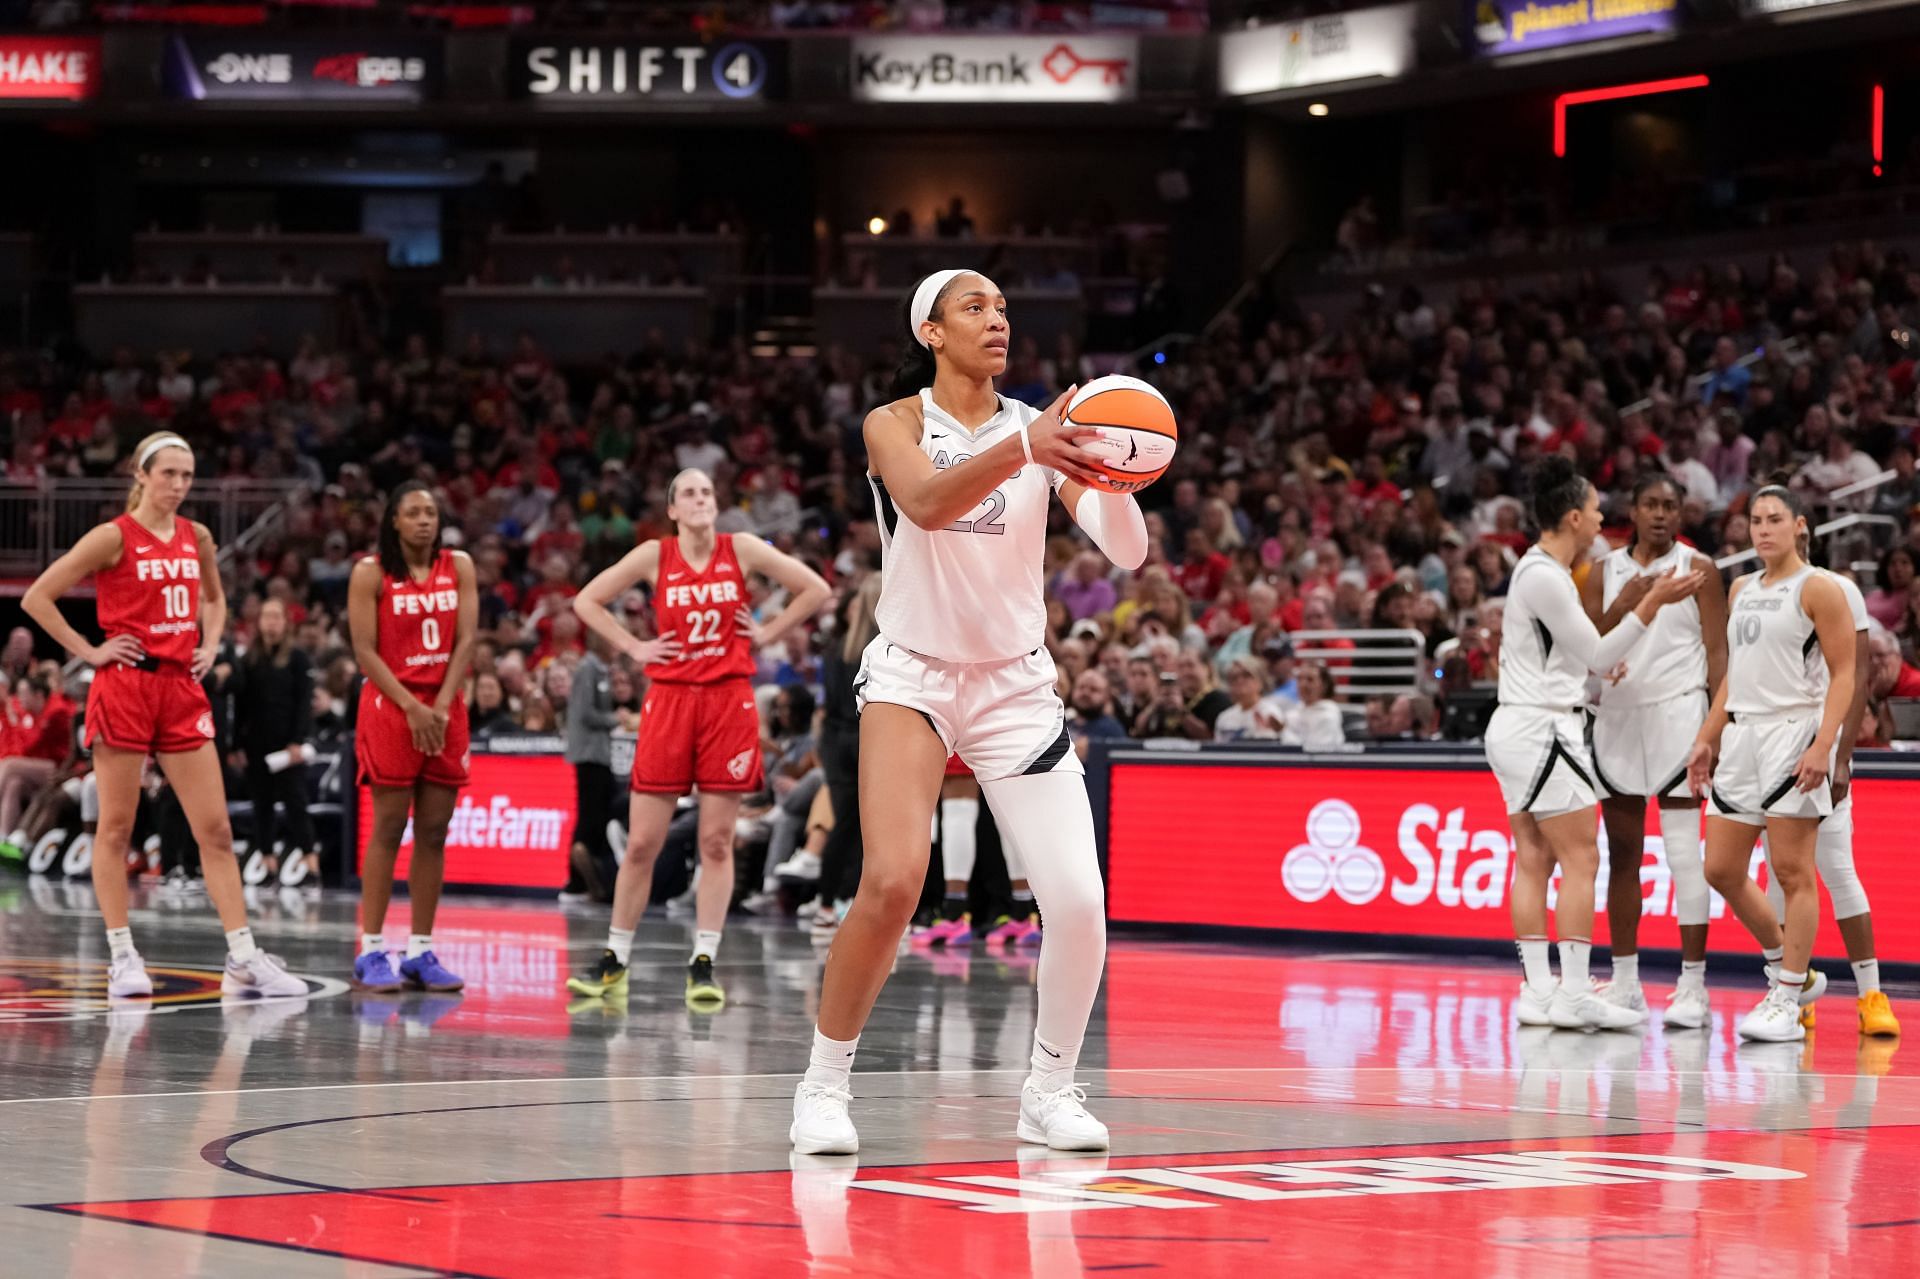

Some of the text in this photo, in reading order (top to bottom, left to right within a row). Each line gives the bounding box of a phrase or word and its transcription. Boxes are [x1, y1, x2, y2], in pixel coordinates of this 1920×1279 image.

[528, 47, 705, 93] SHIFT
[857, 54, 1031, 91] KeyBank
[161, 584, 190, 618] 10
[392, 589, 458, 616] FEVER
[665, 581, 739, 608] FEVER
[421, 618, 441, 650] 0
[686, 608, 723, 644] 22
[1736, 614, 1761, 647] 10
